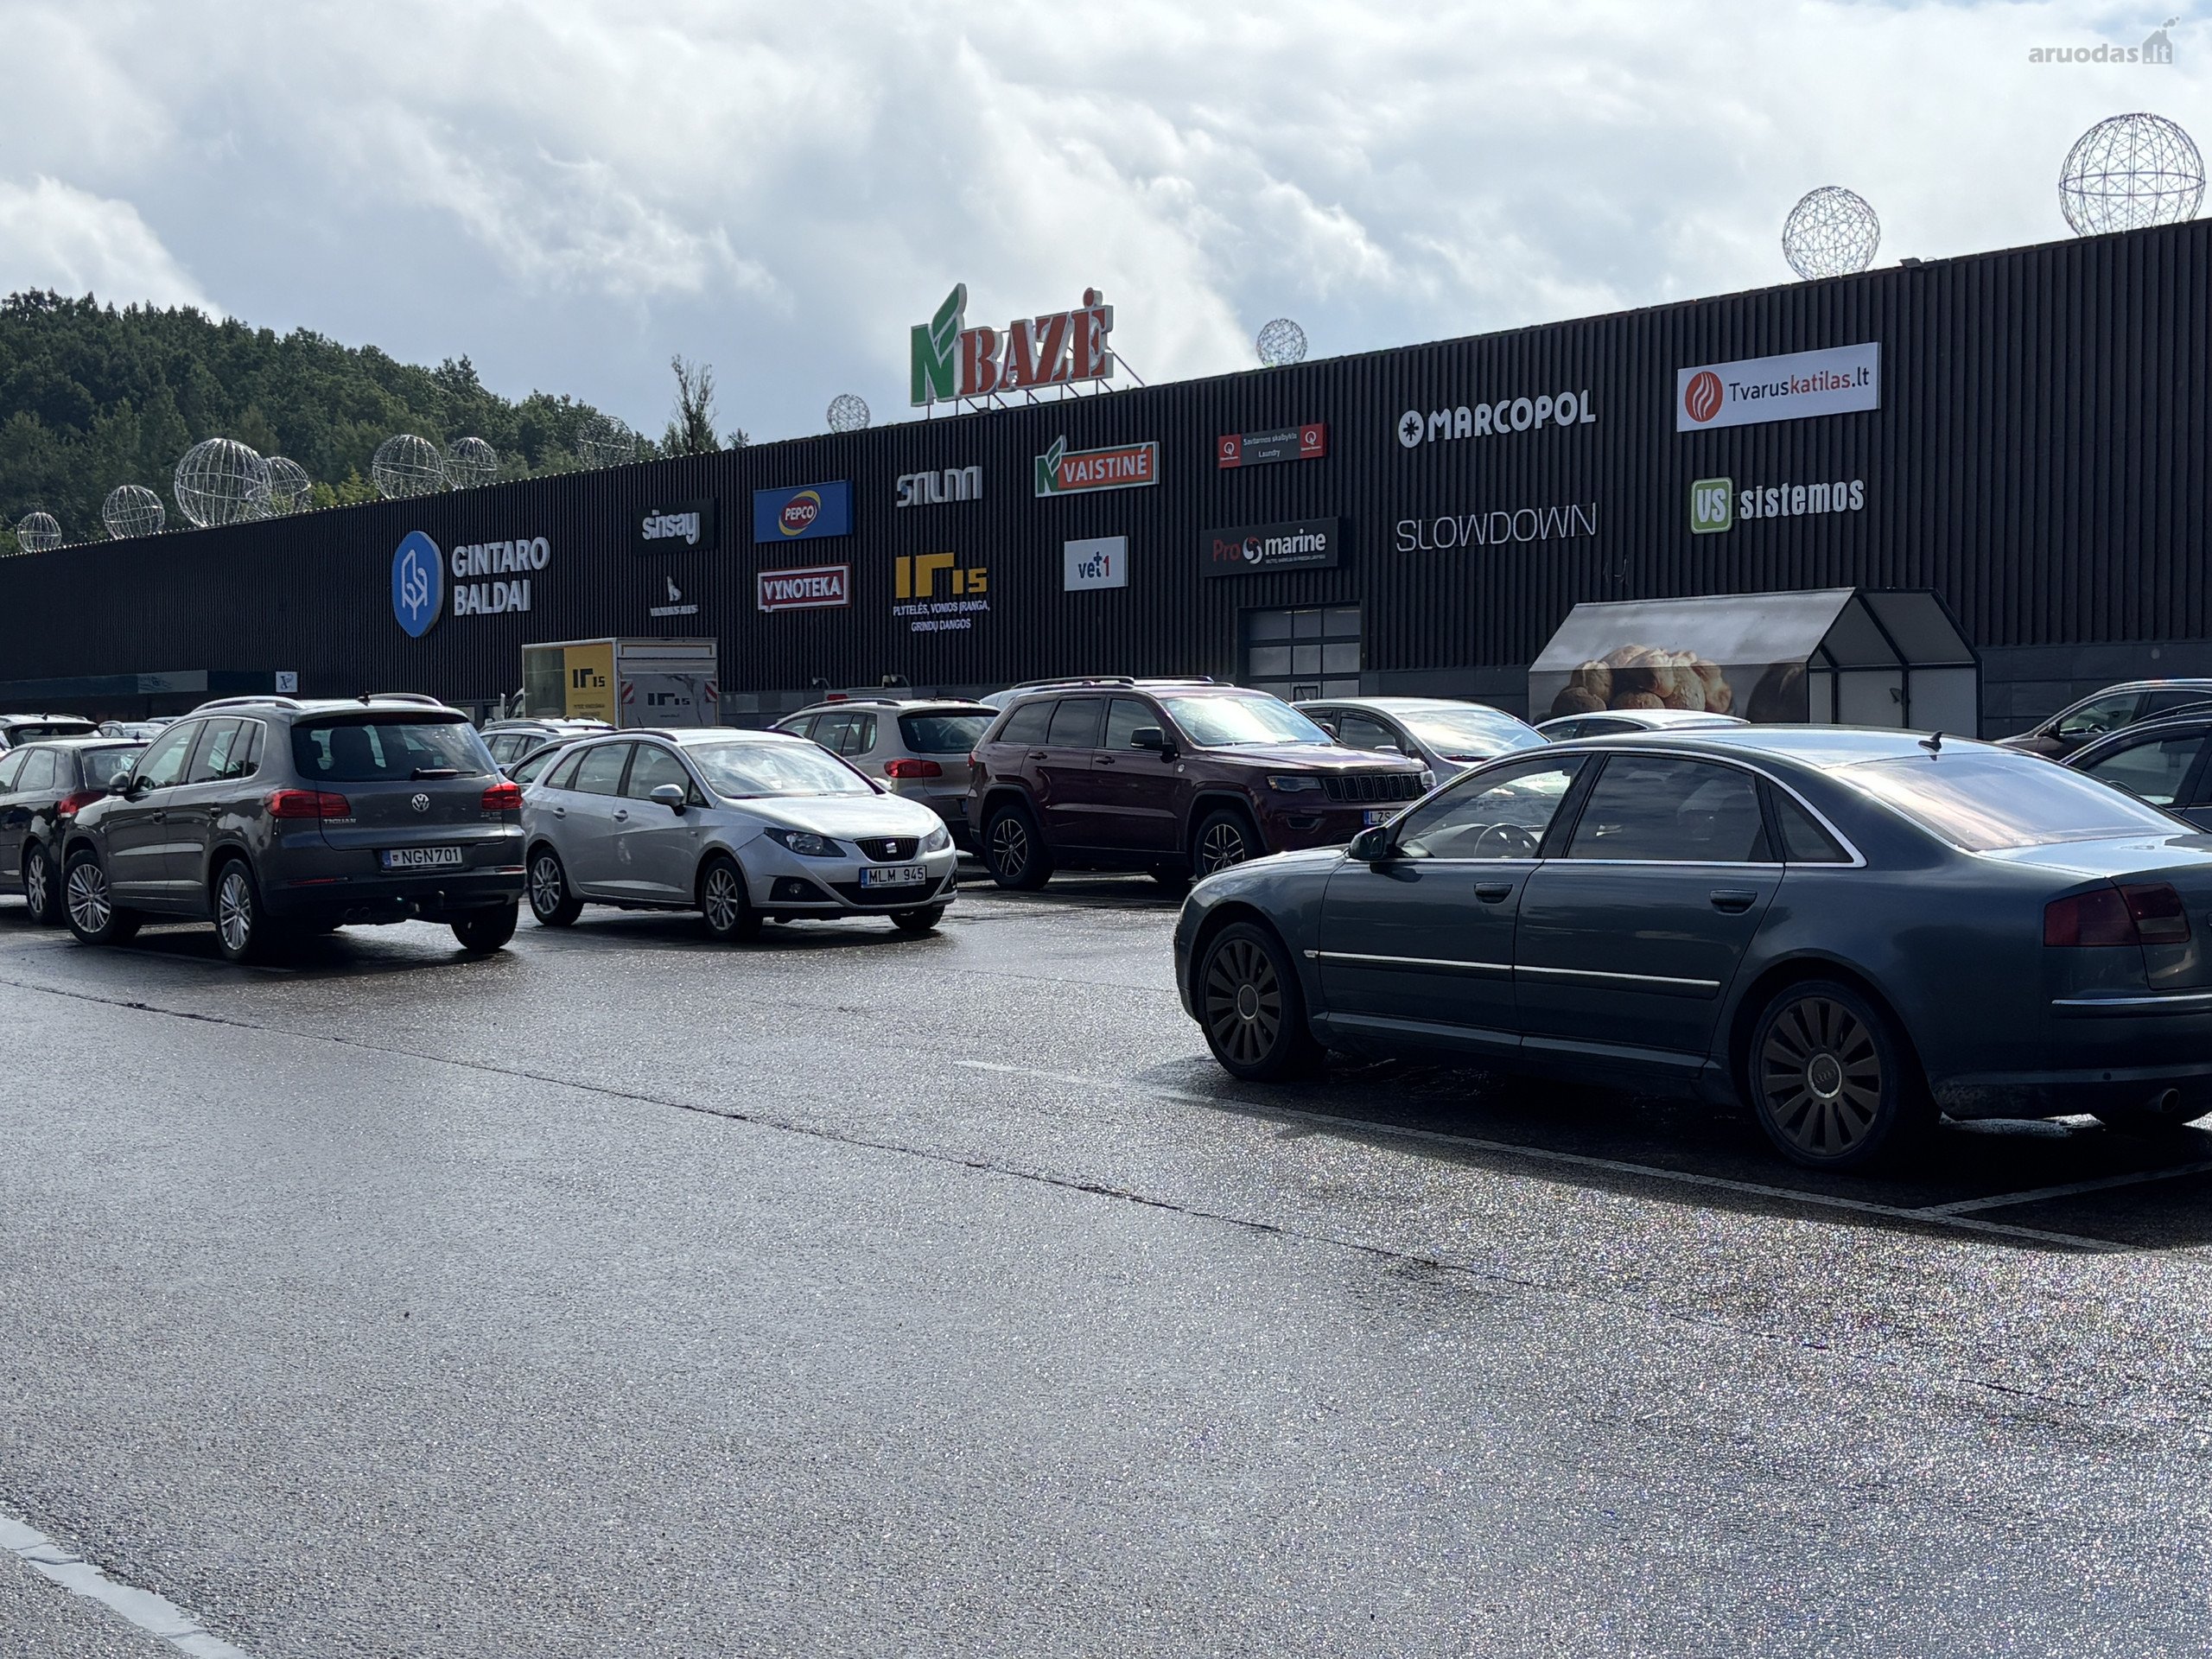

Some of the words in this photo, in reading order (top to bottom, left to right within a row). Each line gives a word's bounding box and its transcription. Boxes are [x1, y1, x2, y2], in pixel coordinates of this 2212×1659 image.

[1728, 365, 1872, 404] Tvaruskatilas.lt
[1427, 389, 1597, 442] MARCOPOL
[785, 505, 816, 522] PEPCO
[1739, 479, 1866, 520] sistemos
[642, 509, 700, 545] sinsay
[1395, 501, 1598, 552] SLOWDOWN
[451, 536, 550, 578] GINTARO
[1212, 538, 1241, 563] Pro
[1265, 528, 1326, 556] marine
[453, 578, 531, 617] BALDAI
[763, 575, 843, 601] VYNOTEKA
[939, 618, 971, 631] DANGOS
[401, 848, 460, 865] NGN701
[868, 868, 896, 883] MLM
[903, 867, 925, 880] 945
